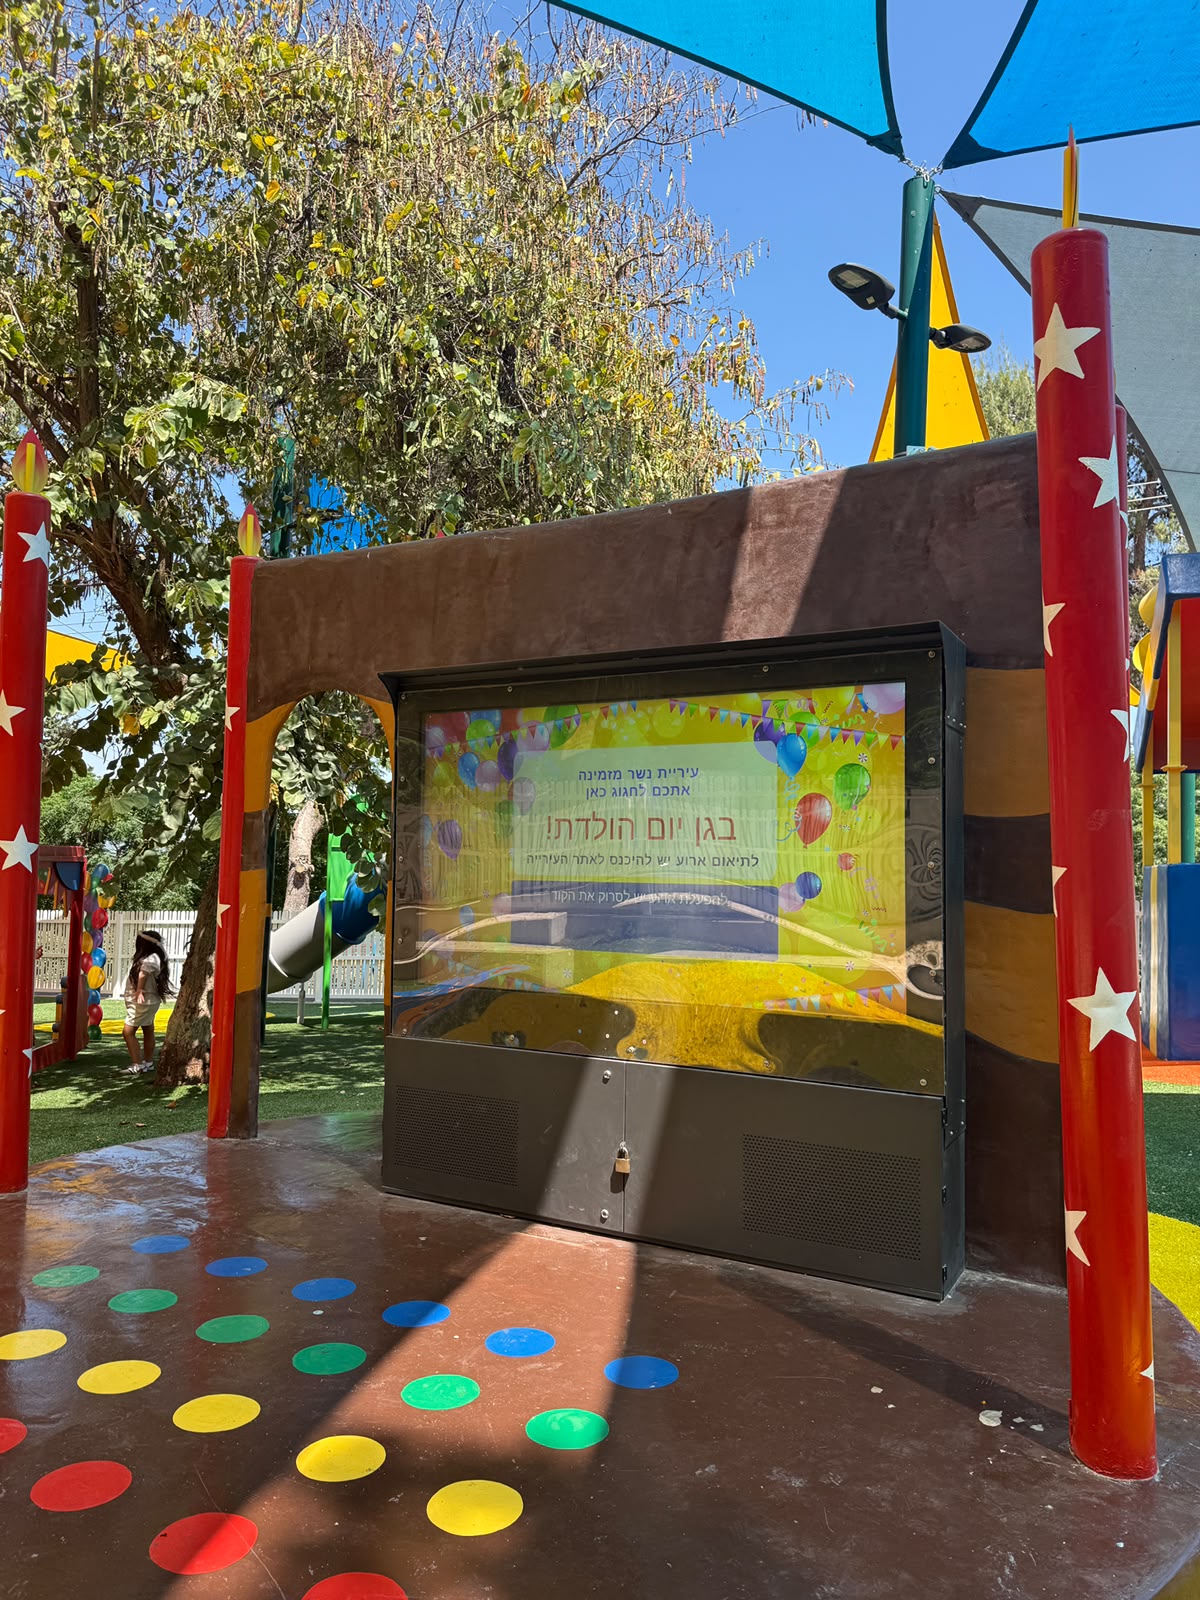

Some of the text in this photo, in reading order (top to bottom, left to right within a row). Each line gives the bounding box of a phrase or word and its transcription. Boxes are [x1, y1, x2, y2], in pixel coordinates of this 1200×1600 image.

[578, 767, 699, 781] עיריית נשר מזמינה
[586, 784, 690, 800] אתכם לחגוג כאן
[547, 811, 736, 847] בגן יום הולדת!
[526, 853, 759, 867] לתיאום ארוע יש להיכנס לאתר העירייה
[552, 890, 576, 903] הקוד
[578, 891, 595, 902] את
[598, 889, 631, 904] לסרוק
